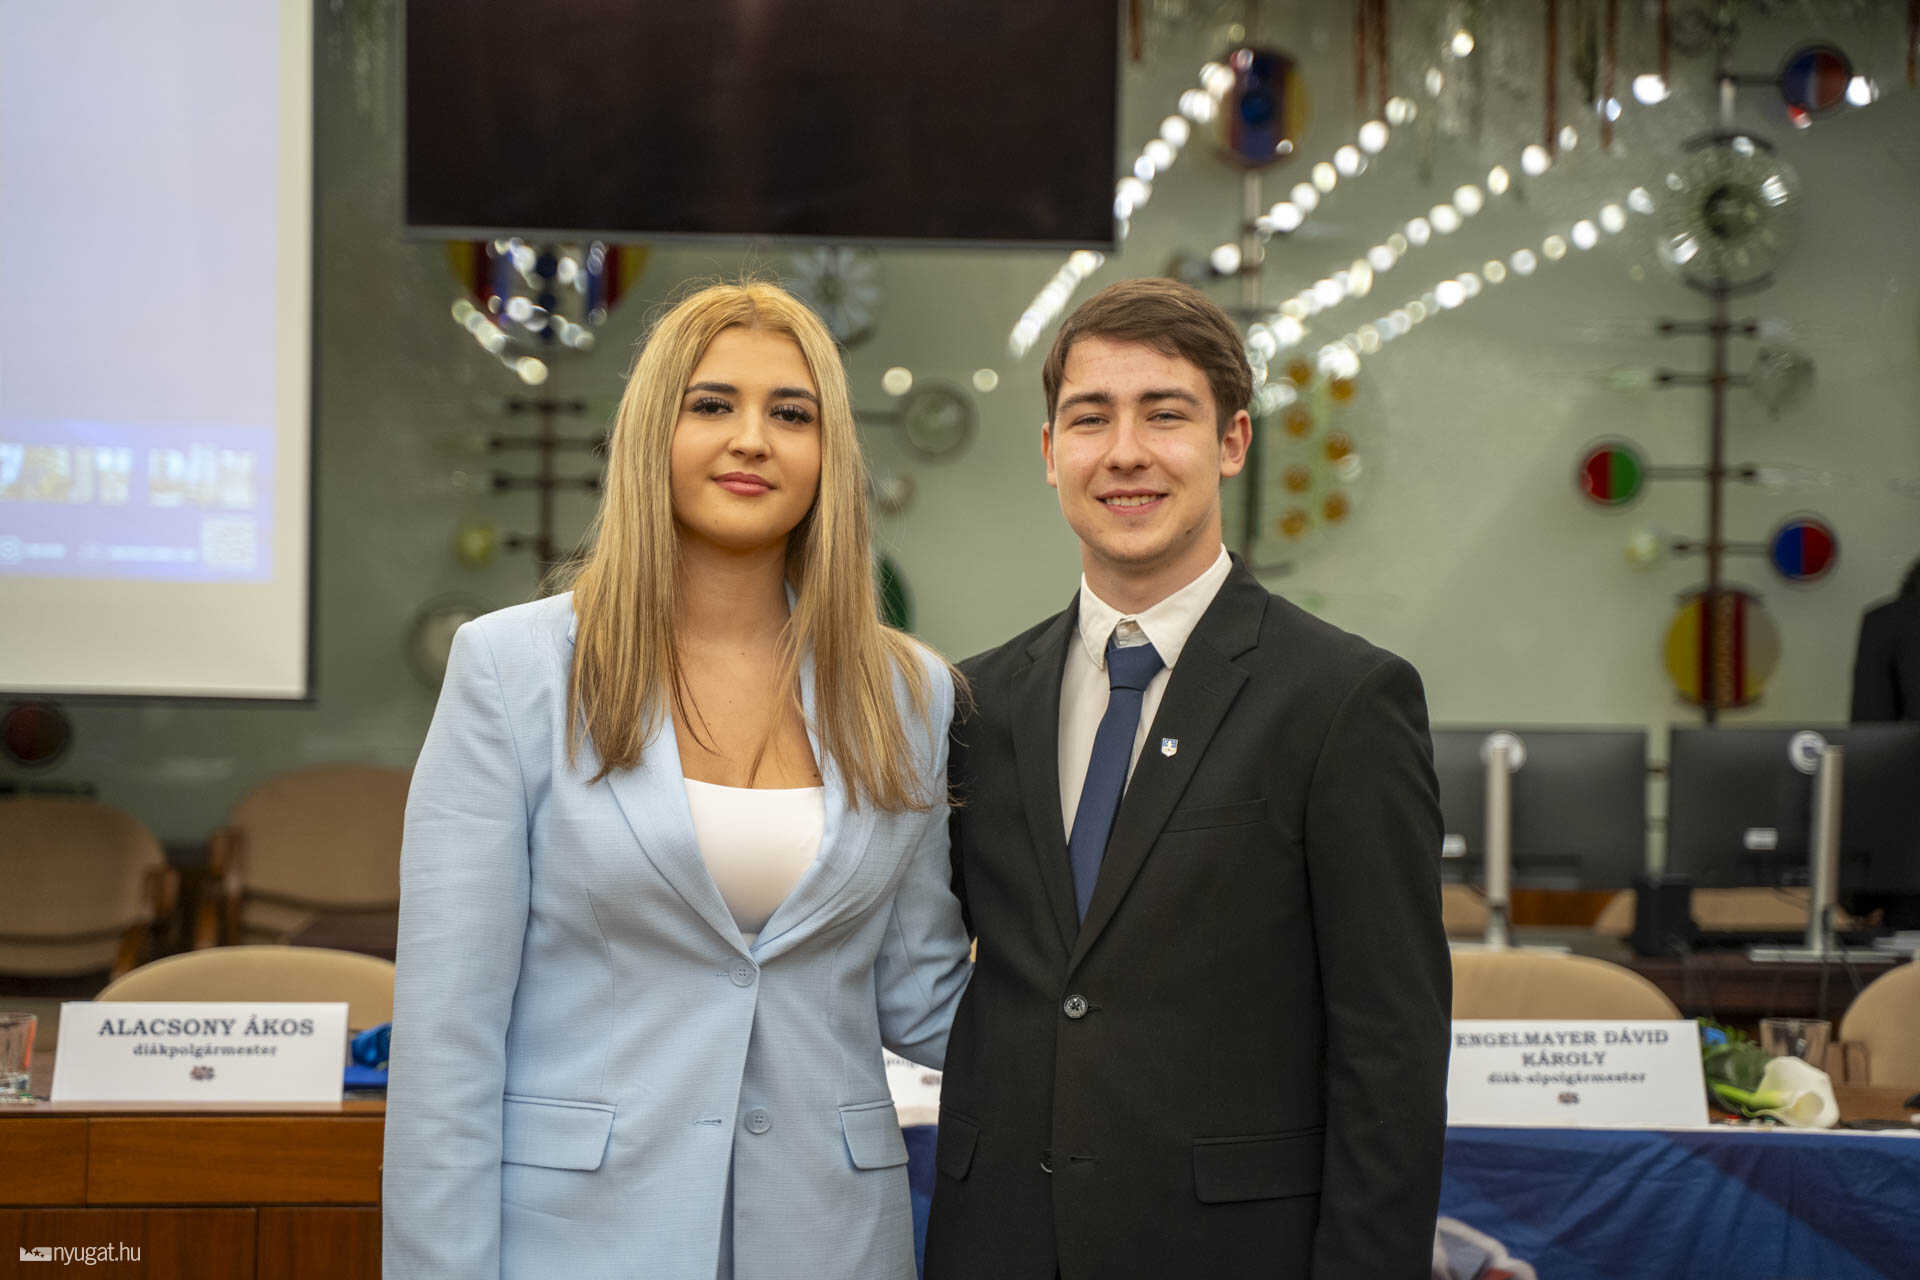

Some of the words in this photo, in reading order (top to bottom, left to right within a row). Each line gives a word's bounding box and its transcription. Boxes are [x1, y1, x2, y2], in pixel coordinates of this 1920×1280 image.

[99, 1018, 236, 1036] ALACSONY
[244, 1013, 314, 1036] ÁKOS
[1456, 1030, 1597, 1047] ENGELMAYER
[1604, 1026, 1669, 1045] DÁVID
[132, 1042, 277, 1058] diákpolgármester
[1521, 1048, 1606, 1067] KÁROLY
